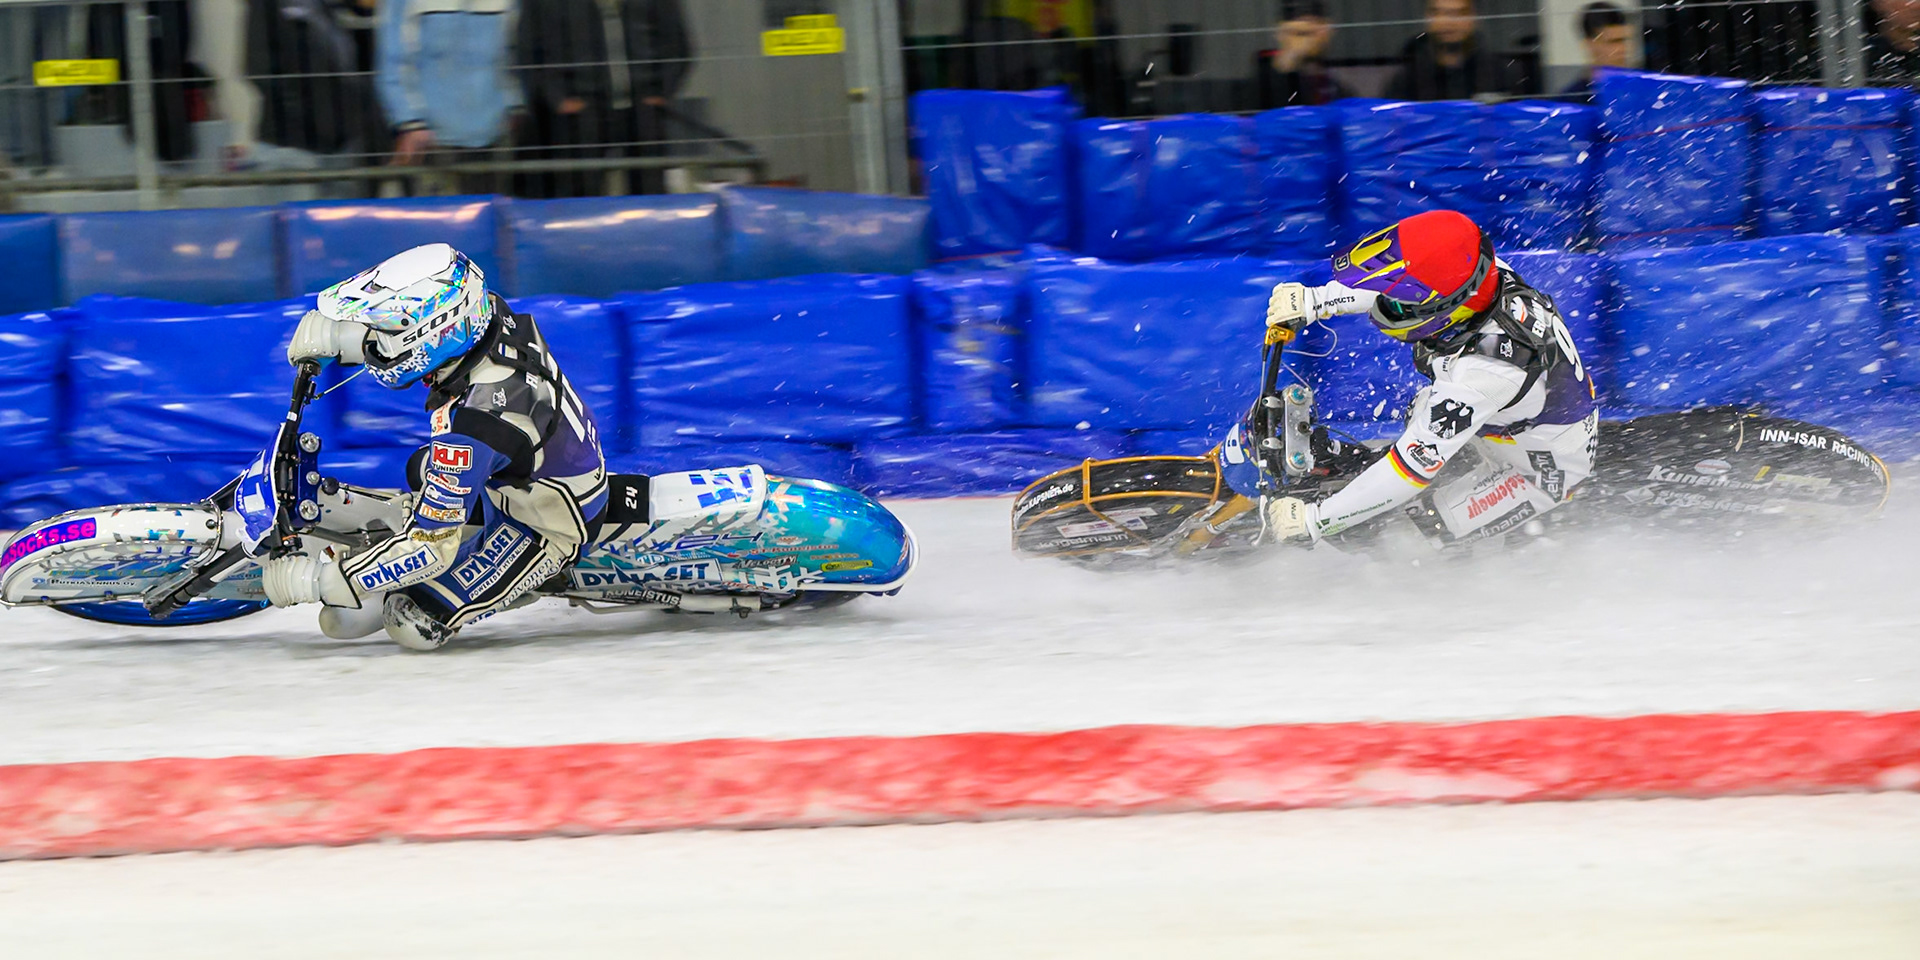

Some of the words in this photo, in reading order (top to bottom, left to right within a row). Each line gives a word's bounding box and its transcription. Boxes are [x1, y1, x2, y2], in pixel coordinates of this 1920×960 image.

[1760, 428, 1827, 451] INN-ISAR
[1832, 440, 1870, 468] RACING
[432, 463, 462, 473] TUNING
[626, 486, 639, 510] 24
[458, 528, 515, 584] DYNASET
[361, 550, 429, 589] DYNASET
[582, 563, 709, 586] DYNASET
[470, 573, 498, 599] POWERED
